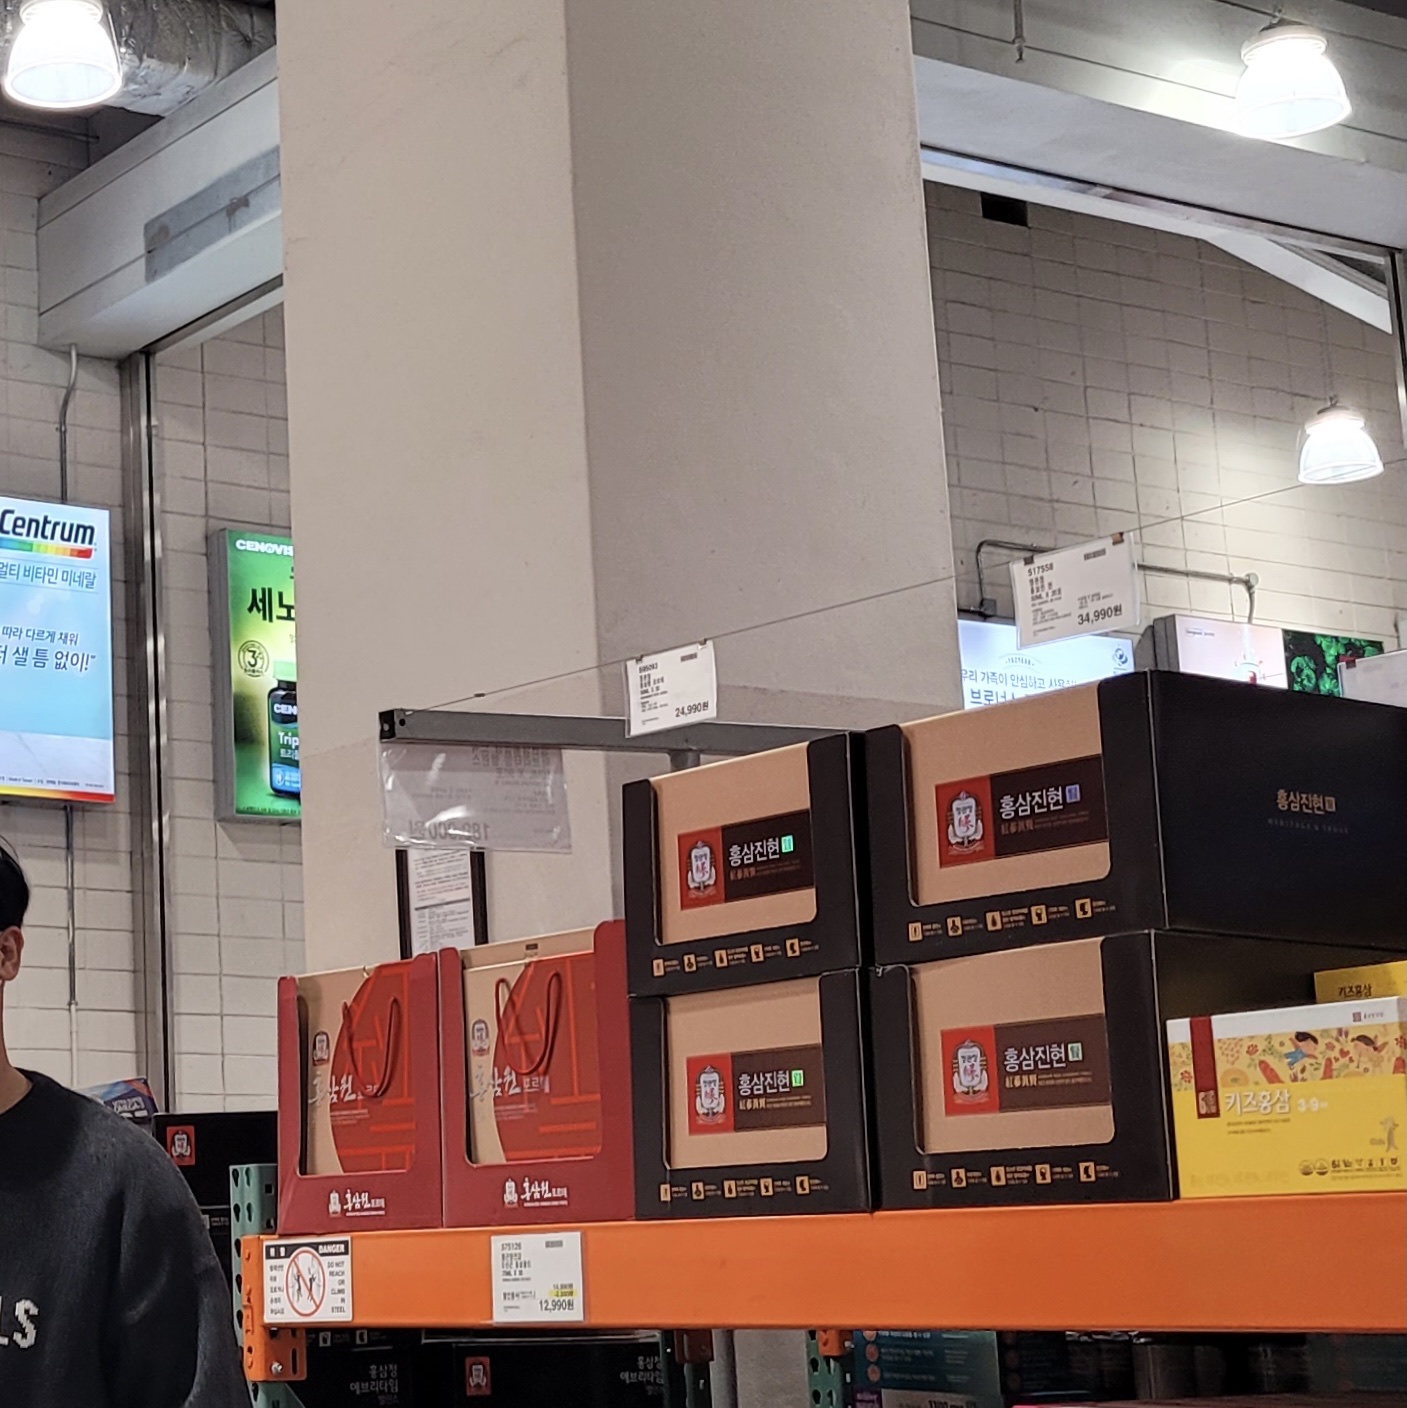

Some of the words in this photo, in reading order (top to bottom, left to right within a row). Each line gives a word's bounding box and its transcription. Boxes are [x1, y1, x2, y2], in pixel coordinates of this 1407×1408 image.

[23, 564, 59, 585] 비타민
[61, 567, 97, 590] 미네랄
[1027, 562, 1054, 577] 517558
[1077, 603, 1123, 626] 34,990원
[2, 625, 24, 640] 따라
[25, 628, 56, 643] 다르게
[58, 631, 79, 647] 채워
[11, 647, 30, 666] 샐
[33, 648, 49, 667] 틈
[980, 671, 1008, 687] 가족이
[1010, 673, 1046, 689] 안심하고
[674, 701, 709, 718] 24,990원
[999, 785, 1064, 820] 홍삼진현
[1276, 789, 1326, 815] 홍삼진현
[728, 837, 781, 867] 홍삼진현
[1337, 983, 1373, 999] 키즈홍삼
[1003, 1042, 1067, 1073] 홍삼진현
[738, 1069, 791, 1097] 홍삼진현
[1224, 1090, 1291, 1115] 키즈홍삼
[318, 1244, 345, 1254] DANGER
[539, 1299, 574, 1313] 12,990원
[368, 1363, 399, 1380] 홍삼정
[349, 1379, 399, 1395] 에브리타임
